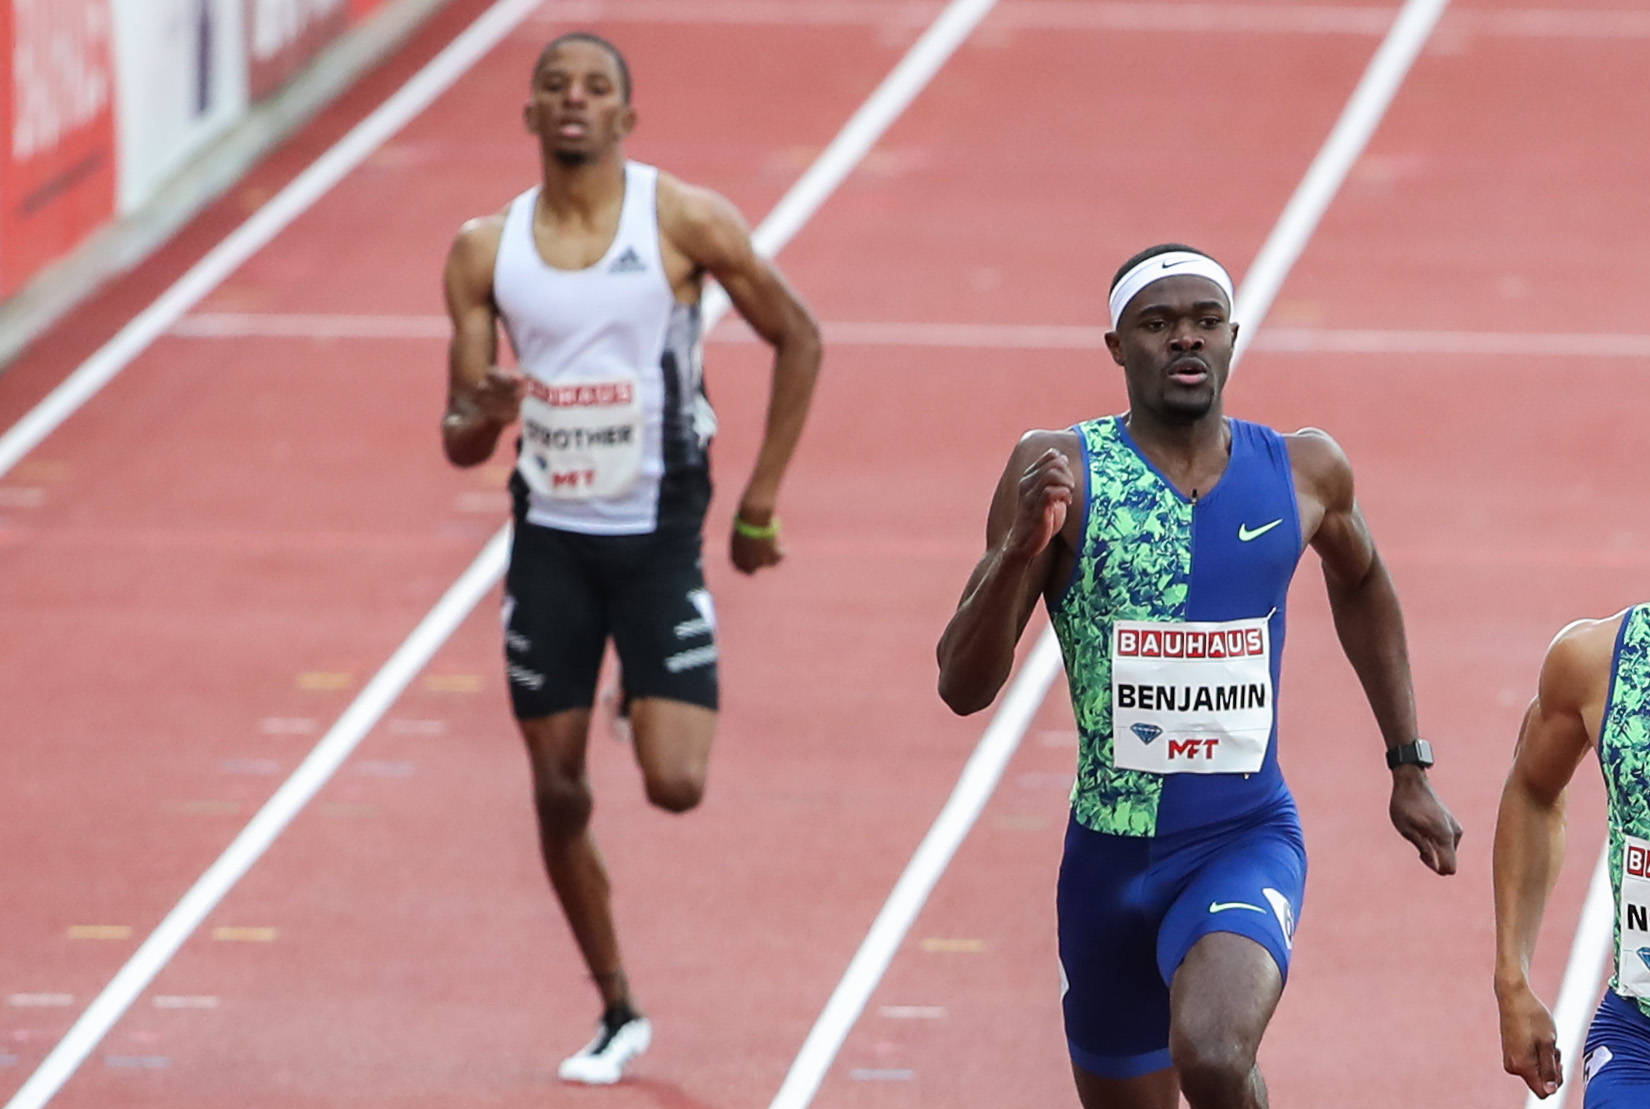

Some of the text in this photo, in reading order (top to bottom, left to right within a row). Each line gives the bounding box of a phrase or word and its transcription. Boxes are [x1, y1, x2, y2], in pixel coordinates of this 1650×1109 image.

[1119, 630, 1263, 657] BAUHAUS
[1118, 683, 1265, 711] BENJAMIN
[1168, 739, 1219, 760] MFT
